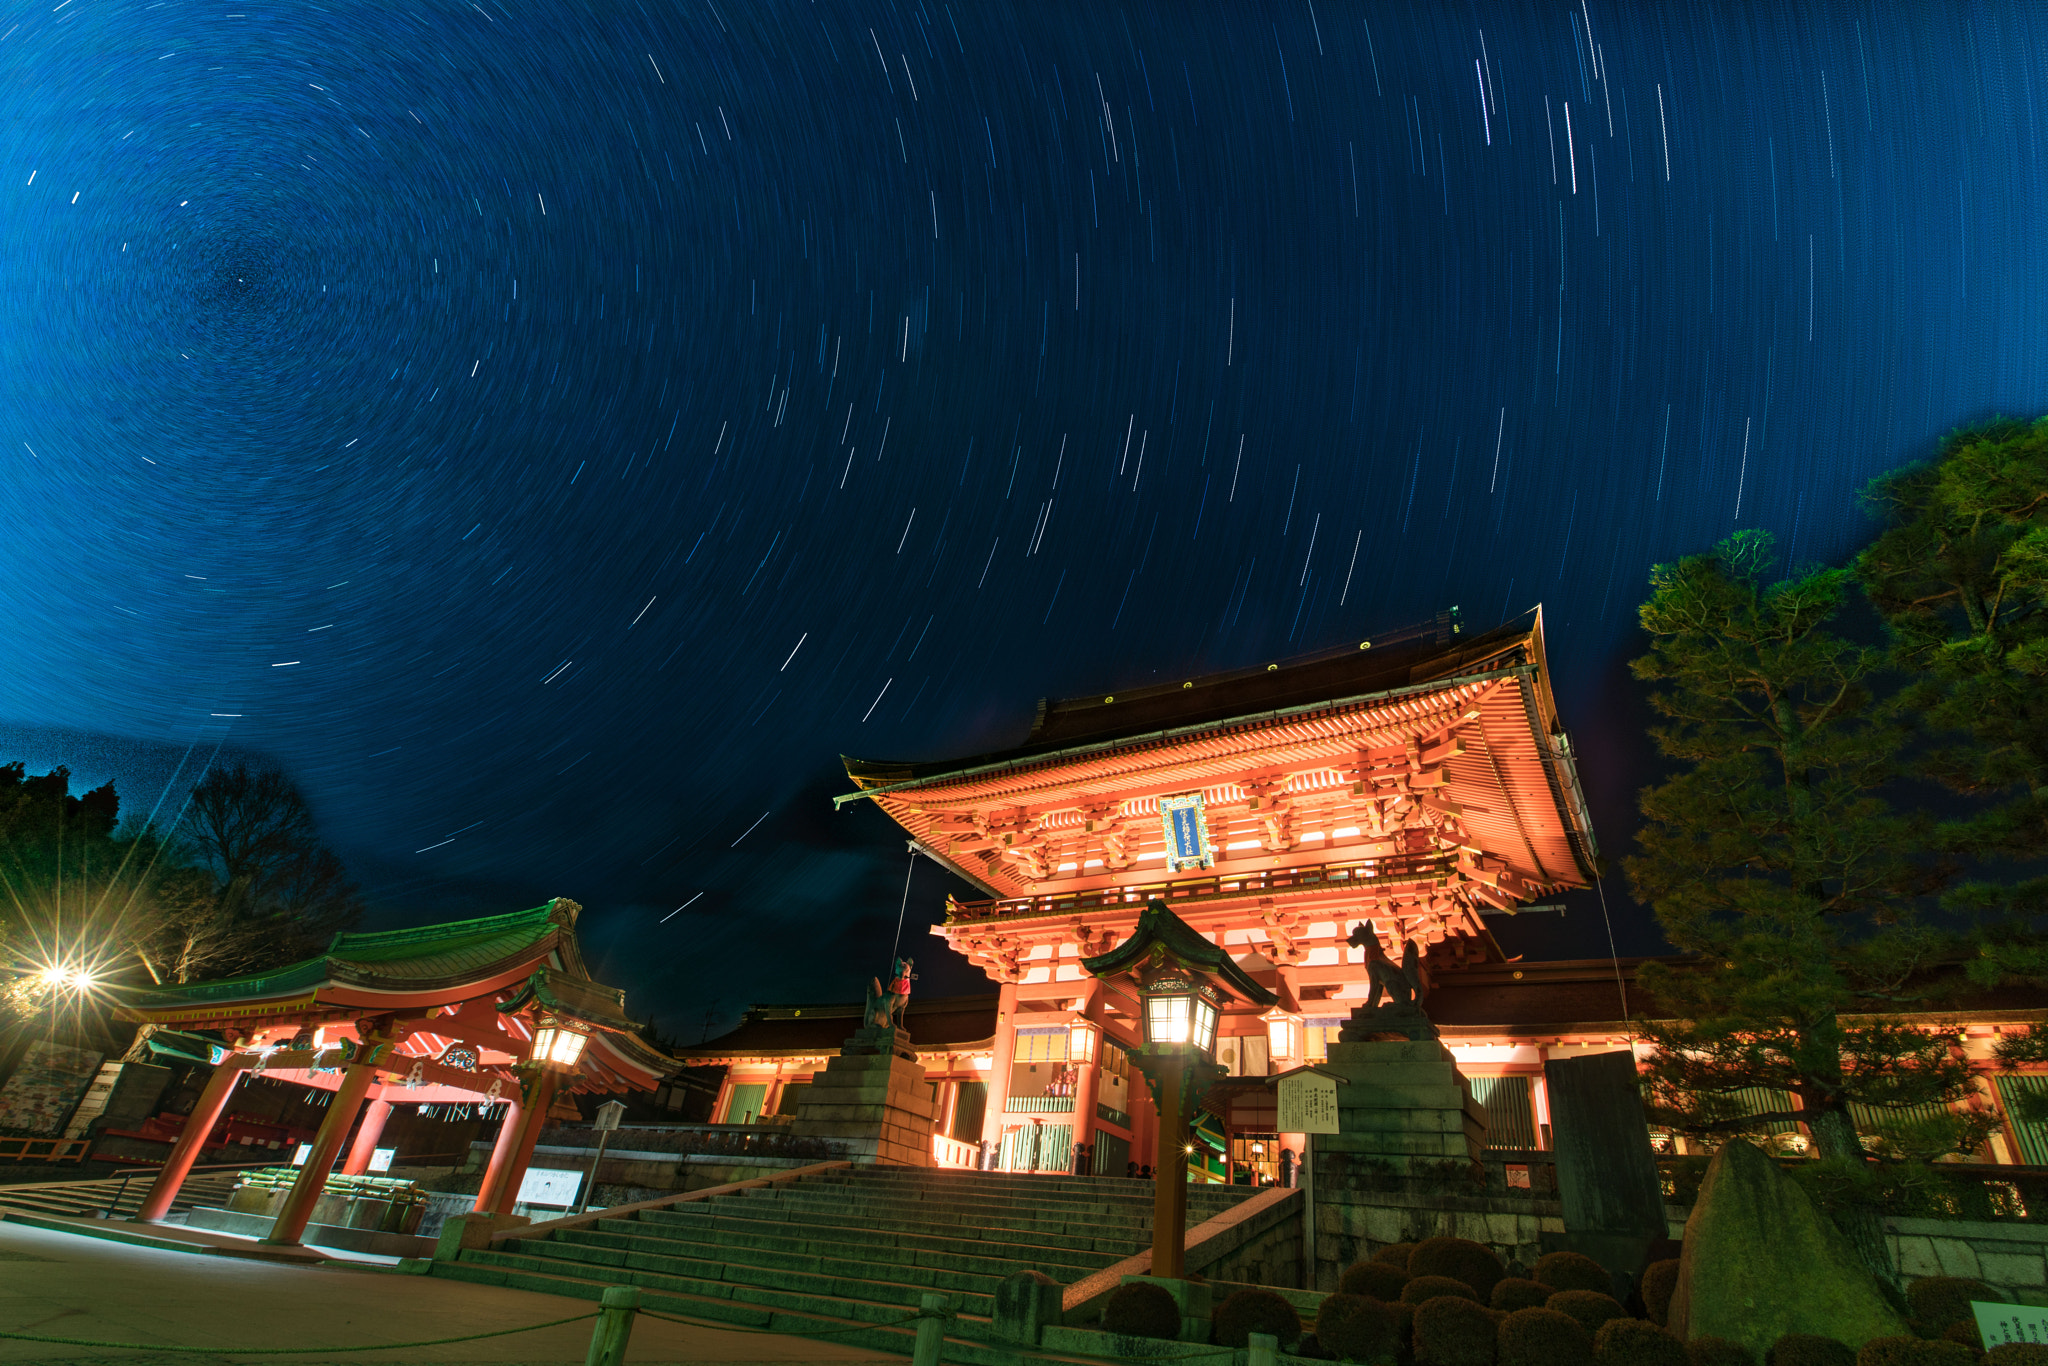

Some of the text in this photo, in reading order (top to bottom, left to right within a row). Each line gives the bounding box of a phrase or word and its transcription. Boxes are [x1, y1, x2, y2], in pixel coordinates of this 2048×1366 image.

[1179, 809, 1194, 855] 伏見稲荷大社
